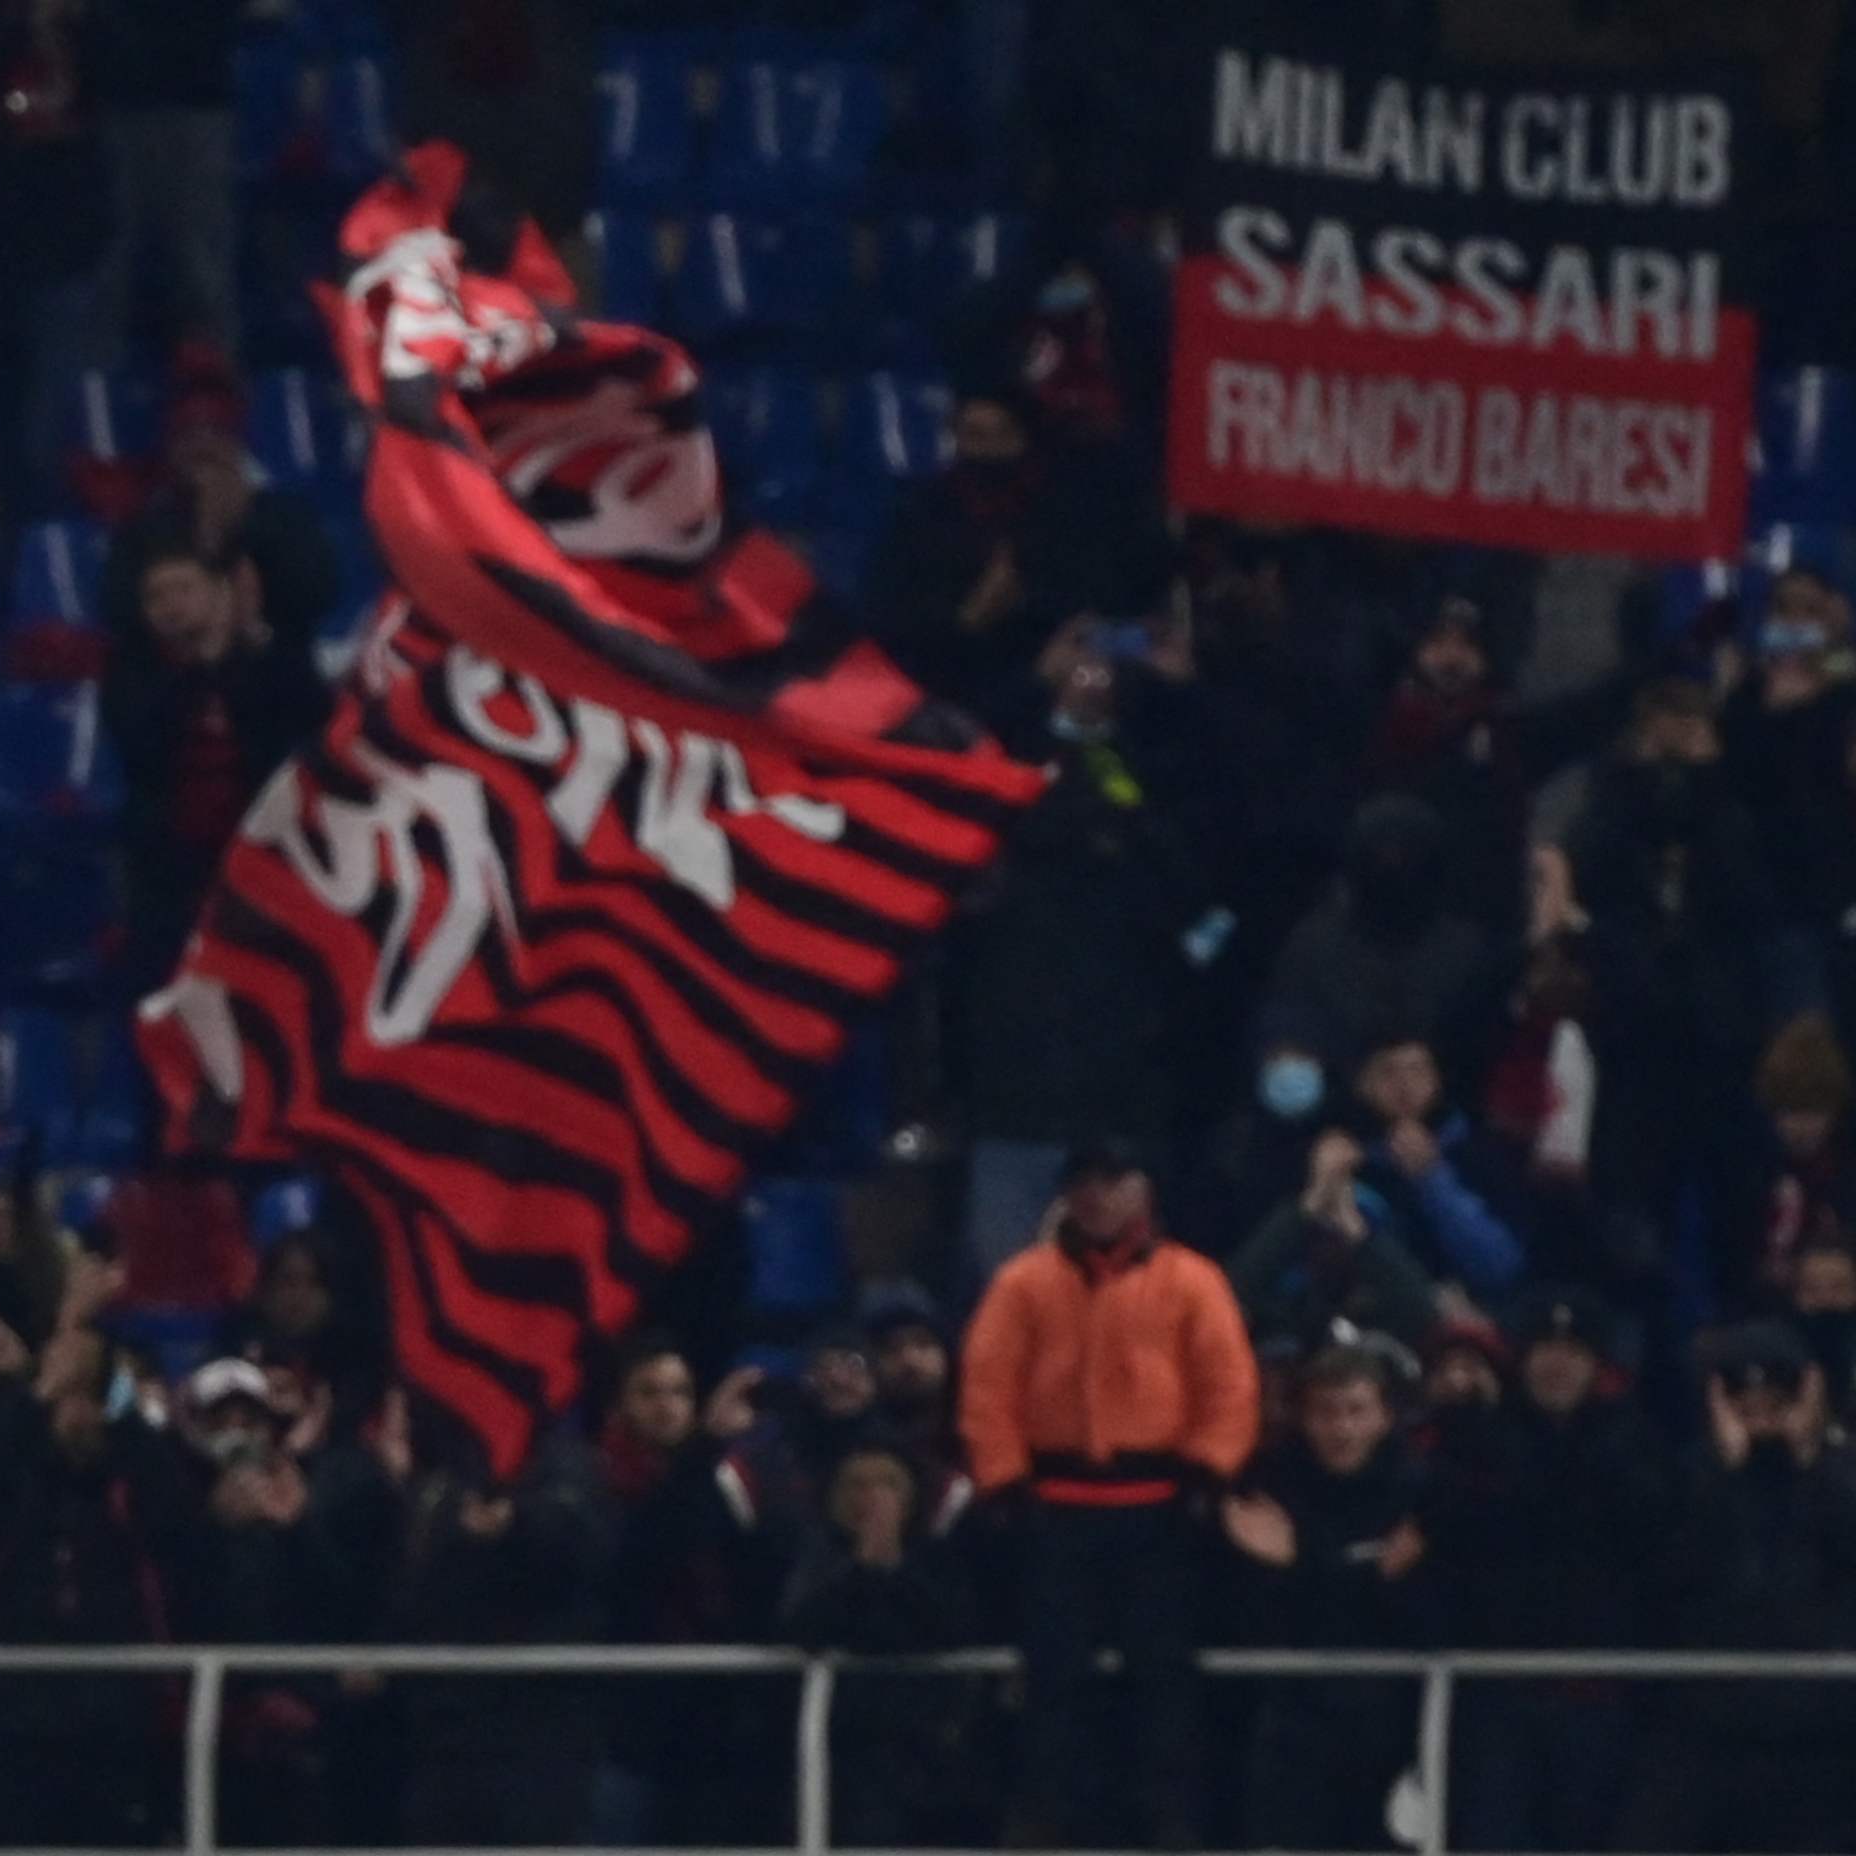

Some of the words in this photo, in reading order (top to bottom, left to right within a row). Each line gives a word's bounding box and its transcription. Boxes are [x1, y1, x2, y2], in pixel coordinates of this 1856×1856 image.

[1213, 48, 1485, 194] MILAN
[1501, 90, 1732, 208] CLUB
[1215, 205, 1721, 363] SASSARI
[1209, 360, 1464, 497] FRANCO
[1473, 388, 1712, 519] BARESI
